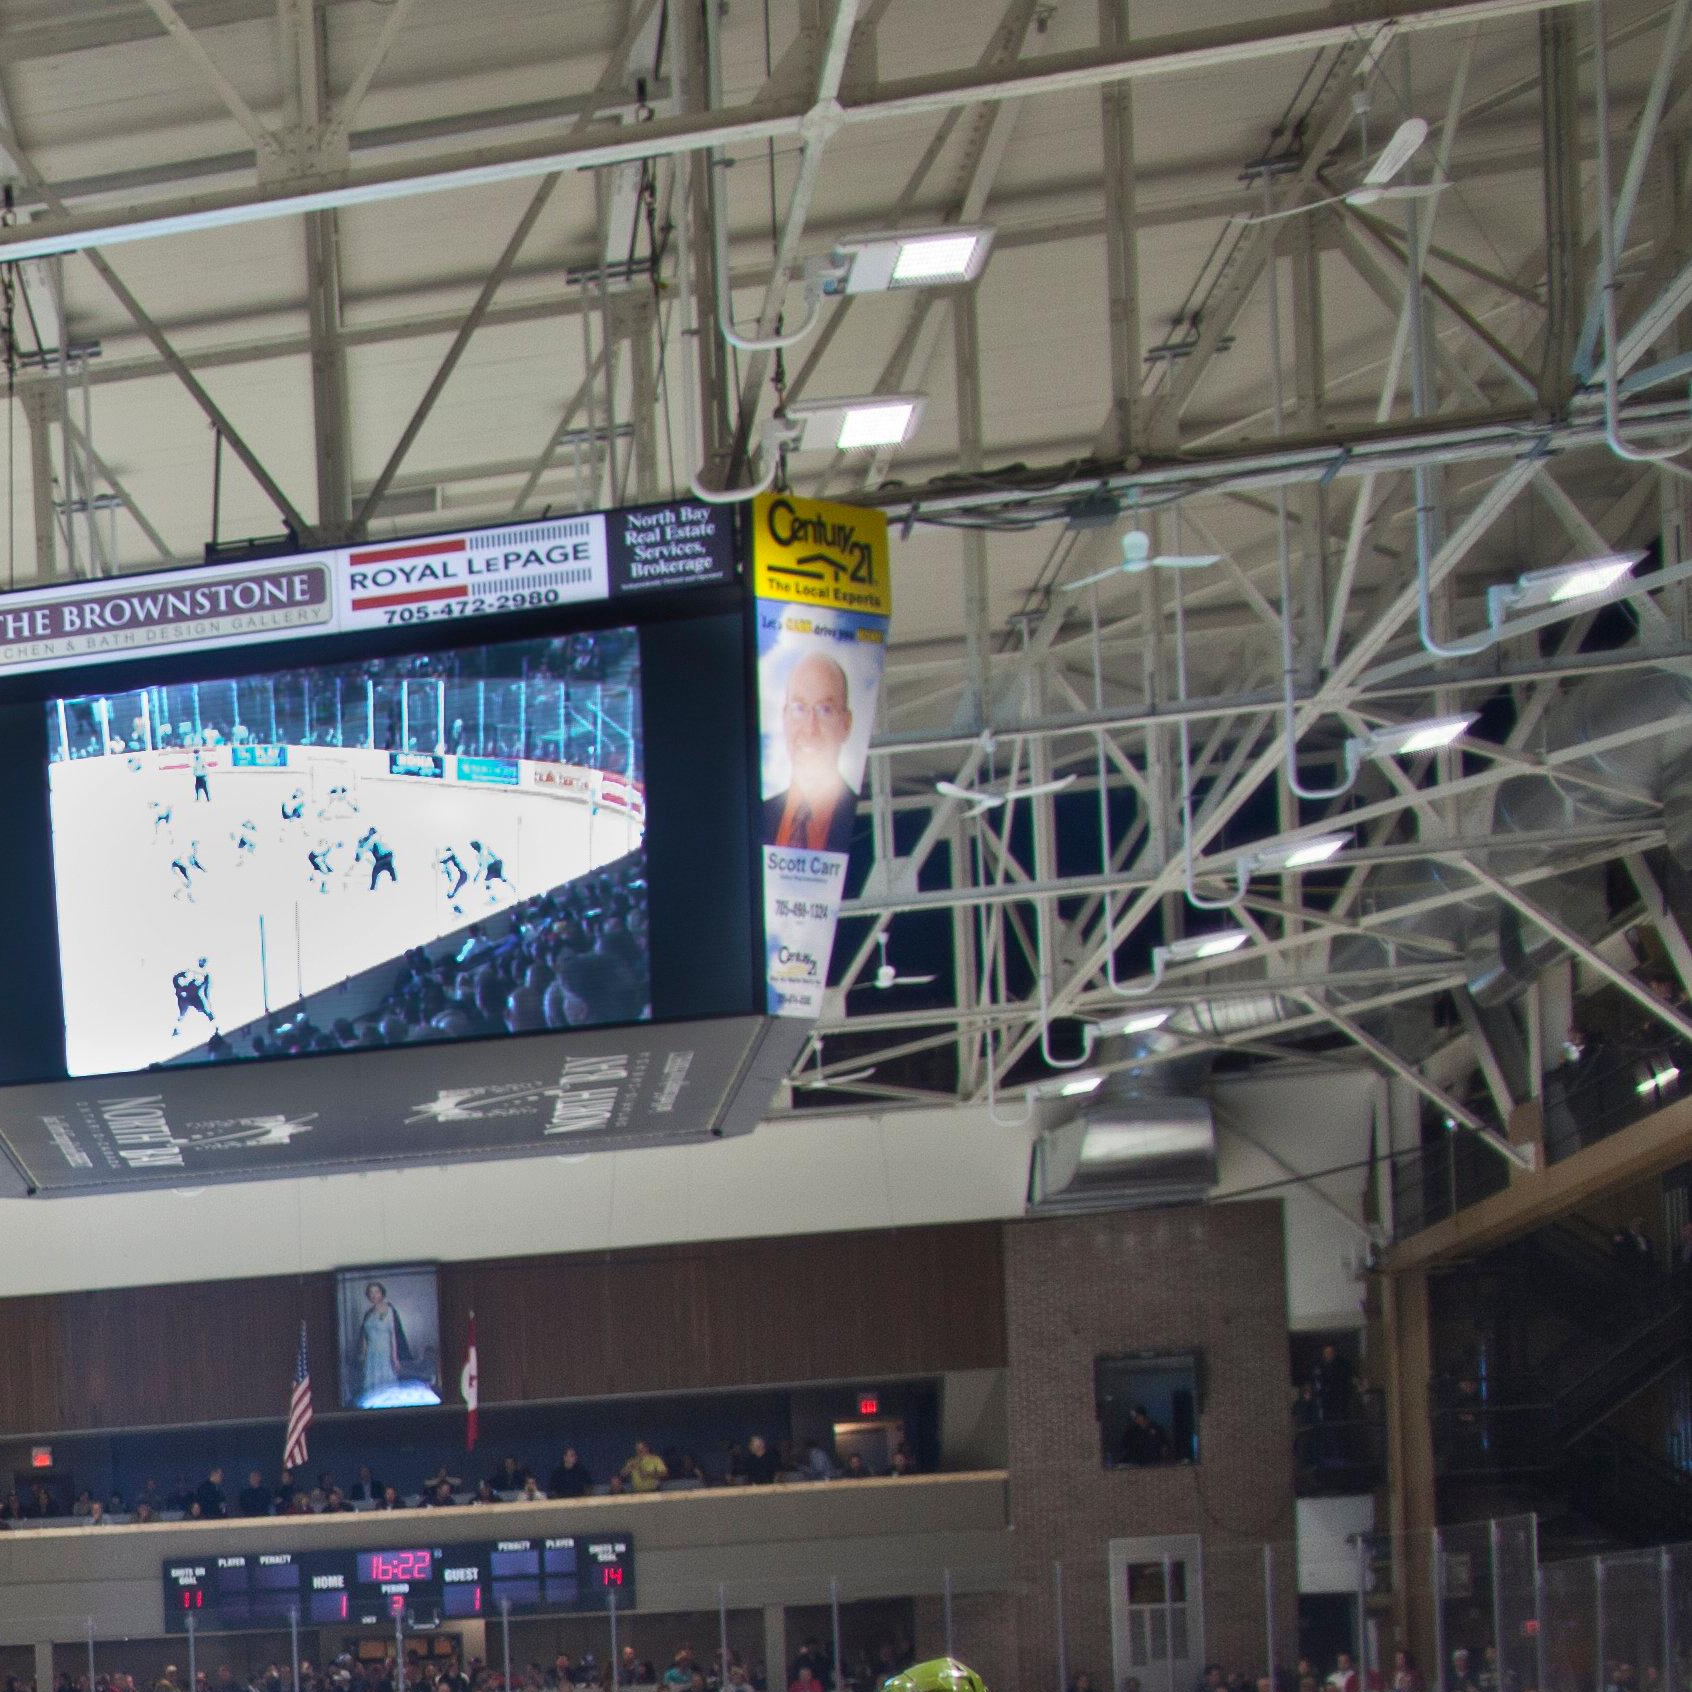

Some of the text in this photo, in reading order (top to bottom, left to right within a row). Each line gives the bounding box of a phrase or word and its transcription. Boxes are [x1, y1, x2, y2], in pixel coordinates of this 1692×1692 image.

[626, 506, 711, 530] North Bay
[768, 500, 856, 554] Century
[623, 521, 716, 546] Real Estate
[350, 560, 459, 592] ROYAL
[630, 556, 714, 580] Brokerage
[850, 541, 873, 585] 21
[61, 574, 311, 633] BROWNSTONE
[383, 588, 560, 625] 705-472-2980
[767, 577, 881, 607] The Local Experts
[65, 639, 76, 653] &
[86, 630, 136, 650] BATH
[146, 620, 221, 643] DESIGN
[230, 606, 324, 631] GALLERY
[768, 851, 842, 878] Scott Carr
[98, 1095, 172, 1144] NORTH
[218, 1557, 246, 1568] PLAYER
[371, 1551, 431, 1581] 16:22
[444, 1567, 479, 1583] GUEST
[602, 1567, 623, 1585] 14
[313, 1575, 345, 1590] HOME
